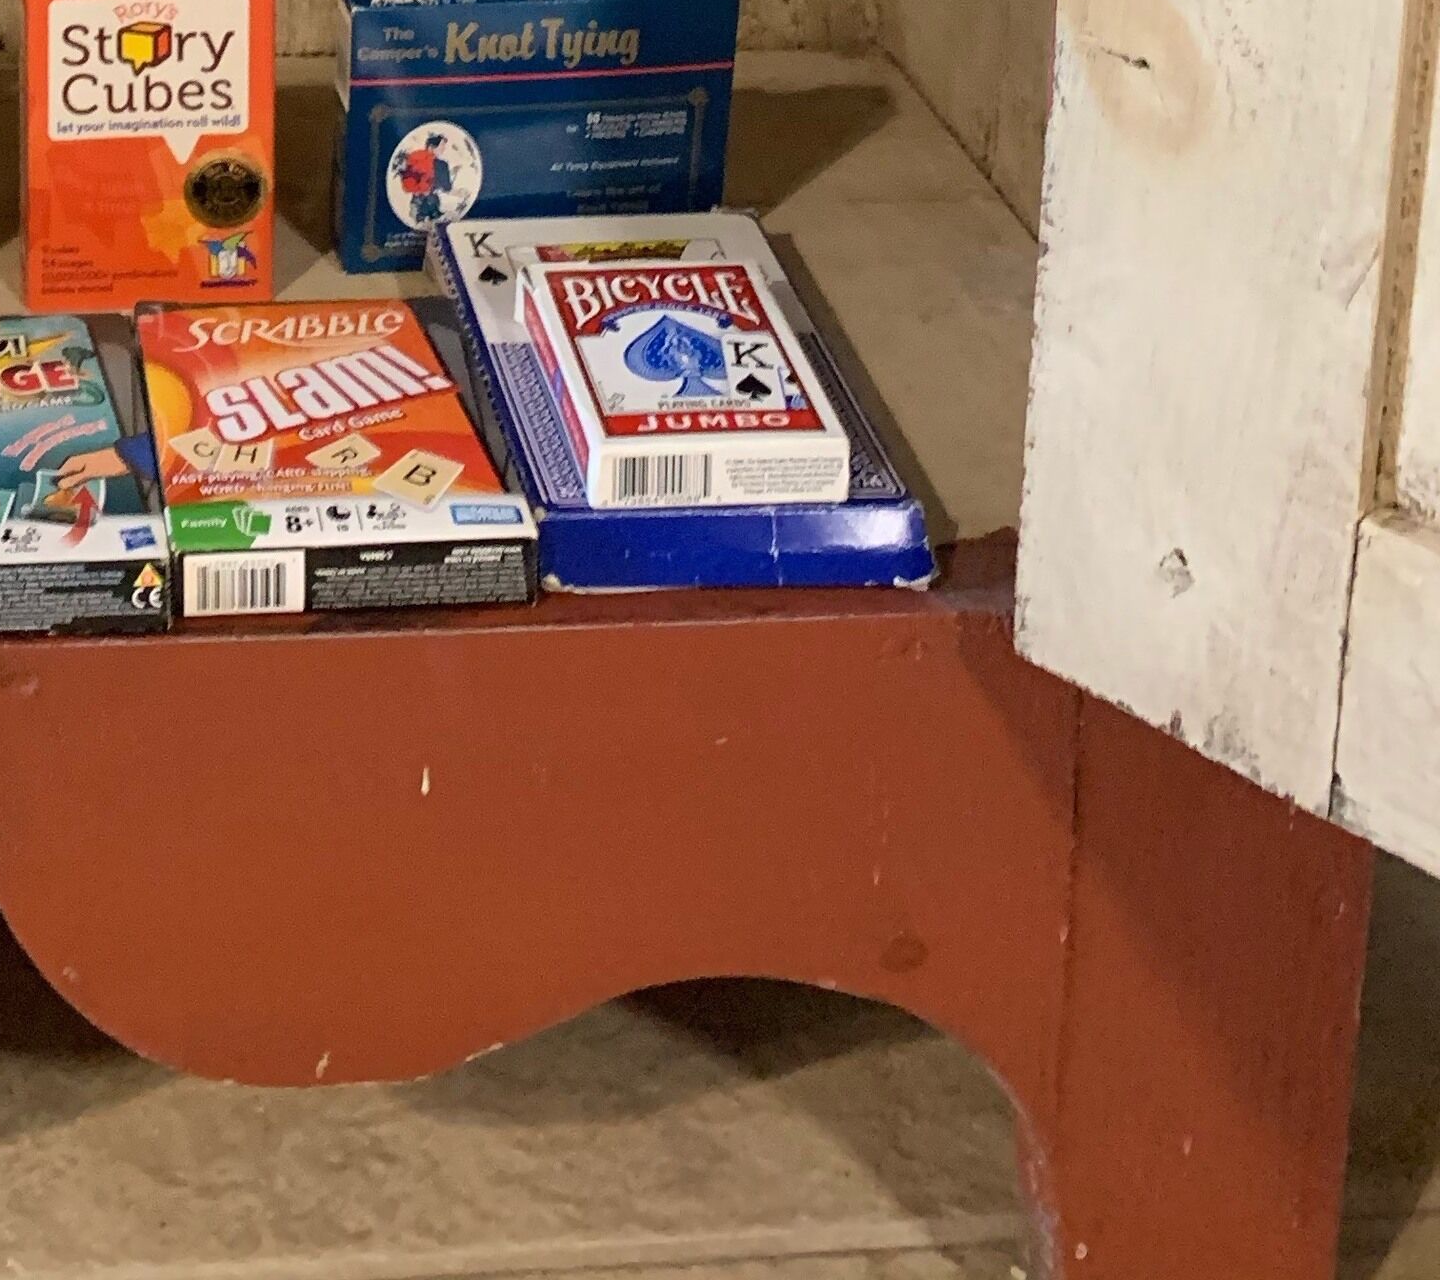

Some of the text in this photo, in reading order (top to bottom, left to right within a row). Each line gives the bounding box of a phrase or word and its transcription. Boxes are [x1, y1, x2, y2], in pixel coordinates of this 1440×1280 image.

[113, 1, 179, 24] Rory's
[382, 27, 416, 42] The
[443, 17, 642, 69] Knot Tying
[62, 73, 234, 116] Cubes
[57, 121, 74, 134] let
[76, 121, 105, 136] your
[108, 117, 184, 133] imagination
[186, 115, 209, 128] roll
[463, 231, 504, 259] K
[560, 271, 761, 331] BICYCLE
[172, 310, 406, 354] SCRABBLE
[726, 340, 775, 370] K
[298, 407, 406, 442] Card Game
[637, 412, 792, 433] JUMBO
[232, 443, 258, 465] H
[402, 462, 438, 488] B
